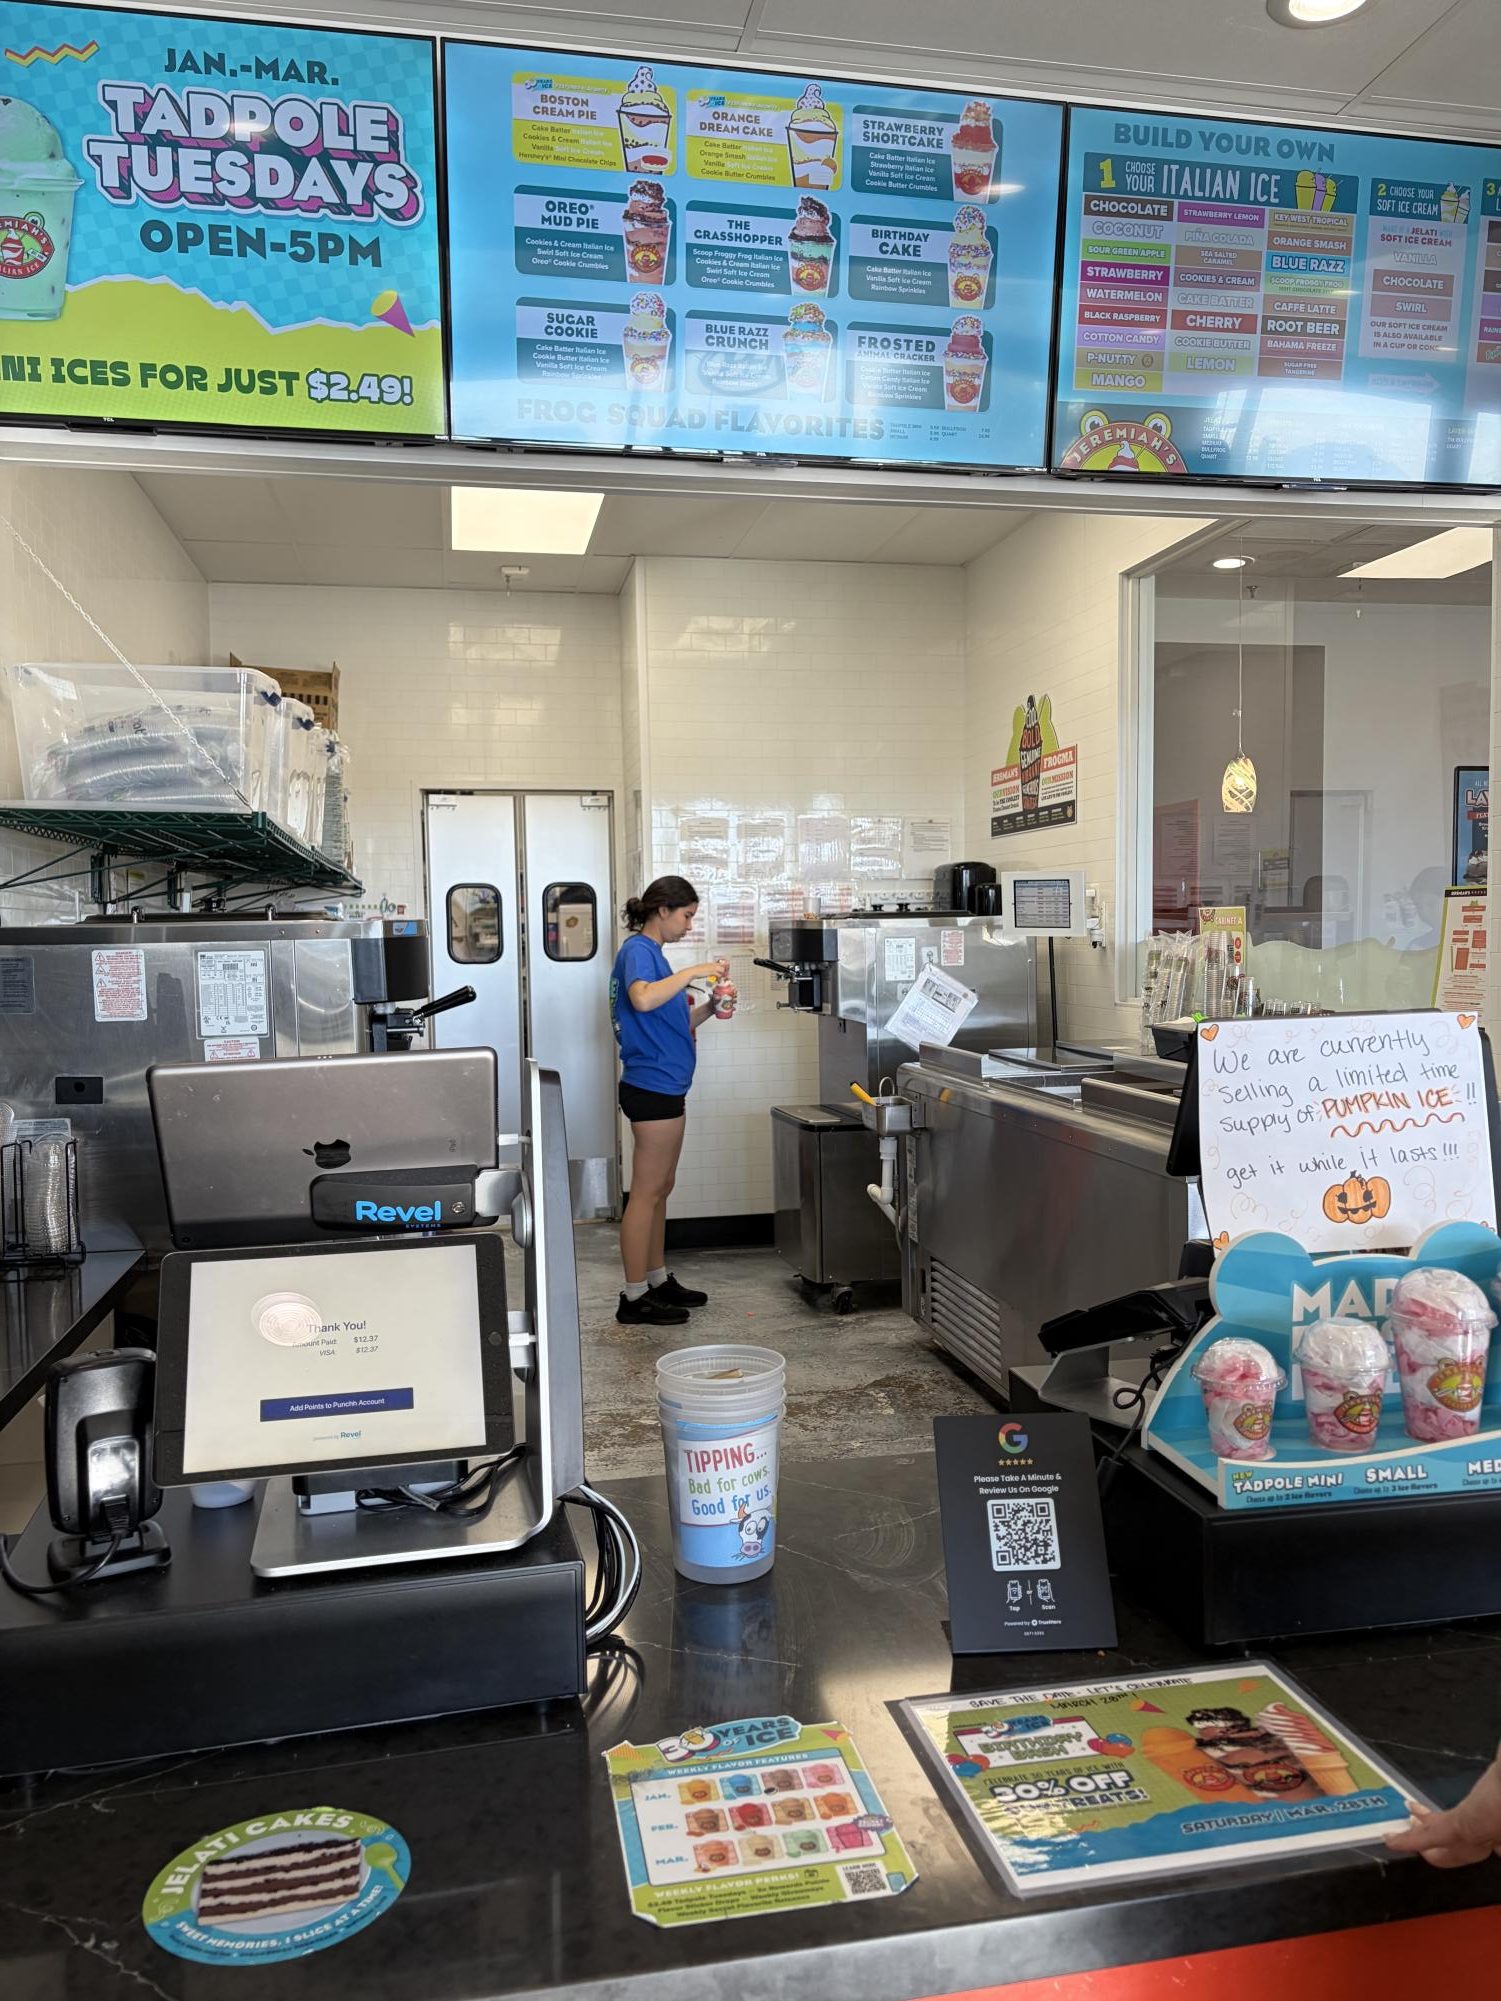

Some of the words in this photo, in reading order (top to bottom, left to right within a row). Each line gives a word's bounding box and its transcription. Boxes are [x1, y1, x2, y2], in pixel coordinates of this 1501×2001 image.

[165, 48, 339, 86] JAN.-MAR.
[541, 94, 589, 107] BOSTON
[100, 83, 395, 155] TADPOLE
[533, 106, 575, 118] CREAM
[578, 110, 596, 120] PIE
[712, 112, 760, 124] ORANGE
[699, 122, 739, 133] DREAM
[743, 126, 773, 137] CAKE
[863, 120, 944, 136] STRAWBERRY
[863, 131, 943, 149] SHORTCAKE
[1114, 123, 1192, 149] BUILD
[1199, 130, 1272, 156] YOUR
[1276, 138, 1335, 163] OWN
[87, 138, 413, 212] TUESDAYS
[1099, 158, 1116, 189] 1
[1125, 161, 1155, 175] CHOOSE
[1125, 174, 1155, 192] YOUR
[1162, 164, 1240, 201] ITALIAN
[1249, 172, 1281, 204] ICE
[1377, 184, 1387, 196] 2
[1390, 187, 1416, 198] CHOOSE
[1418, 188, 1434, 199] YOUR
[1090, 200, 1168, 217] CHOCOLATE
[1183, 208, 1231, 220] STRAWBERRY
[1233, 212, 1259, 222] LEMON
[1377, 199, 1396, 211] SOFT
[1398, 201, 1410, 213] ICE
[1413, 203, 1438, 216] CREAM
[541, 214, 572, 227] MUD
[576, 217, 599, 229] PIE
[727, 220, 750, 230] THE
[140, 220, 382, 268] OPEN-5PM
[694, 230, 783, 245] GRASSHOPPER
[871, 229, 930, 243] BIRTHDAY
[879, 242, 921, 257] CAKE
[1272, 256, 1307, 270] BLUE
[1310, 258, 1345, 273] RAZZ
[1086, 266, 1164, 281] STRAWBERRY
[1383, 276, 1444, 289] CHOCOLATE
[1086, 288, 1163, 303] WATERMELON
[1307, 304, 1337, 315] LATTE
[1394, 302, 1427, 313] SWIRL
[547, 312, 595, 326] SUGAR
[1186, 314, 1242, 330] CHERRY
[544, 325, 598, 338] COOKIE
[705, 324, 735, 336] BLUE
[738, 327, 768, 337] RAZZ
[1267, 320, 1303, 334] ROOT
[1307, 323, 1339, 335] BEER
[705, 335, 768, 350] CRUNCH
[857, 336, 936, 352] FROSTED
[894, 353, 935, 362] CRACKER
[1087, 352, 1136, 365] P-NUTTY
[1186, 356, 1236, 372] LEMON
[51, 358, 130, 386] ICES
[139, 363, 208, 392] FOR
[218, 367, 299, 397] JUST
[307, 369, 413, 405] $2.49!
[1092, 374, 1146, 388] MANGO
[517, 399, 597, 424] FROG
[607, 402, 707, 430] SQUAD
[715, 409, 885, 440] FLAVORITES
[1073, 428, 1177, 465] JEREMIAH'S
[1213, 1048, 1251, 1075] We
[1268, 1047, 1305, 1065] are
[1320, 1030, 1431, 1058] currently
[1308, 1077, 1327, 1093] a
[1336, 1063, 1409, 1089] limited
[1419, 1063, 1460, 1080] time
[1297, 1105, 1316, 1124] of
[1321, 1090, 1412, 1120] PUMPKIN
[1418, 1087, 1454, 1108] ICE
[1226, 1164, 1258, 1189] get
[1270, 1155, 1285, 1175] it
[1299, 1155, 1347, 1173] while
[1360, 1146, 1378, 1170] it
[355, 1200, 442, 1222] Revel
[343, 1320, 366, 1330] You!
[353, 1335, 378, 1343] $12.37
[356, 1346, 378, 1354] $12.37
[358, 1398, 385, 1406] Account
[684, 1442, 768, 1474] TIPPING...
[688, 1477, 711, 1495] Bad
[717, 1477, 736, 1493] for
[742, 1464, 770, 1486] cows.
[973, 1475, 999, 1484] Please
[1000, 1474, 1019, 1482] Take
[1021, 1474, 1027, 1482] A
[1027, 1473, 1054, 1482] Minute
[1365, 1464, 1428, 1484] SMALL
[979, 1487, 1006, 1495] Review
[1008, 1486, 1018, 1494] Us
[1032, 1485, 1059, 1494] Google
[1233, 1476, 1303, 1494] TADPOLE
[1308, 1473, 1344, 1487] MINI
[692, 1499, 725, 1516] Good
[732, 1494, 751, 1511] for
[756, 1484, 772, 1502] us.
[969, 1699, 1006, 1709] SAVE
[1012, 1694, 1036, 1703] THE
[1087, 1685, 1123, 1694] LET'S
[717, 1717, 791, 1737] YEARS
[746, 1727, 796, 1746] ICE
[667, 1766, 709, 1776] WEEKLY
[712, 1761, 753, 1771] FLAVOR
[755, 1754, 808, 1764] FEATURES
[991, 1778, 1068, 1802] 30%
[1068, 1771, 1134, 1792] OFF
[1182, 1812, 1273, 1834] SATURDAY
[1286, 1803, 1334, 1819] MAR.
[1337, 1795, 1387, 1812] 28TH
[162, 1831, 241, 1895] JELATI
[245, 1813, 354, 1836] CAKES
